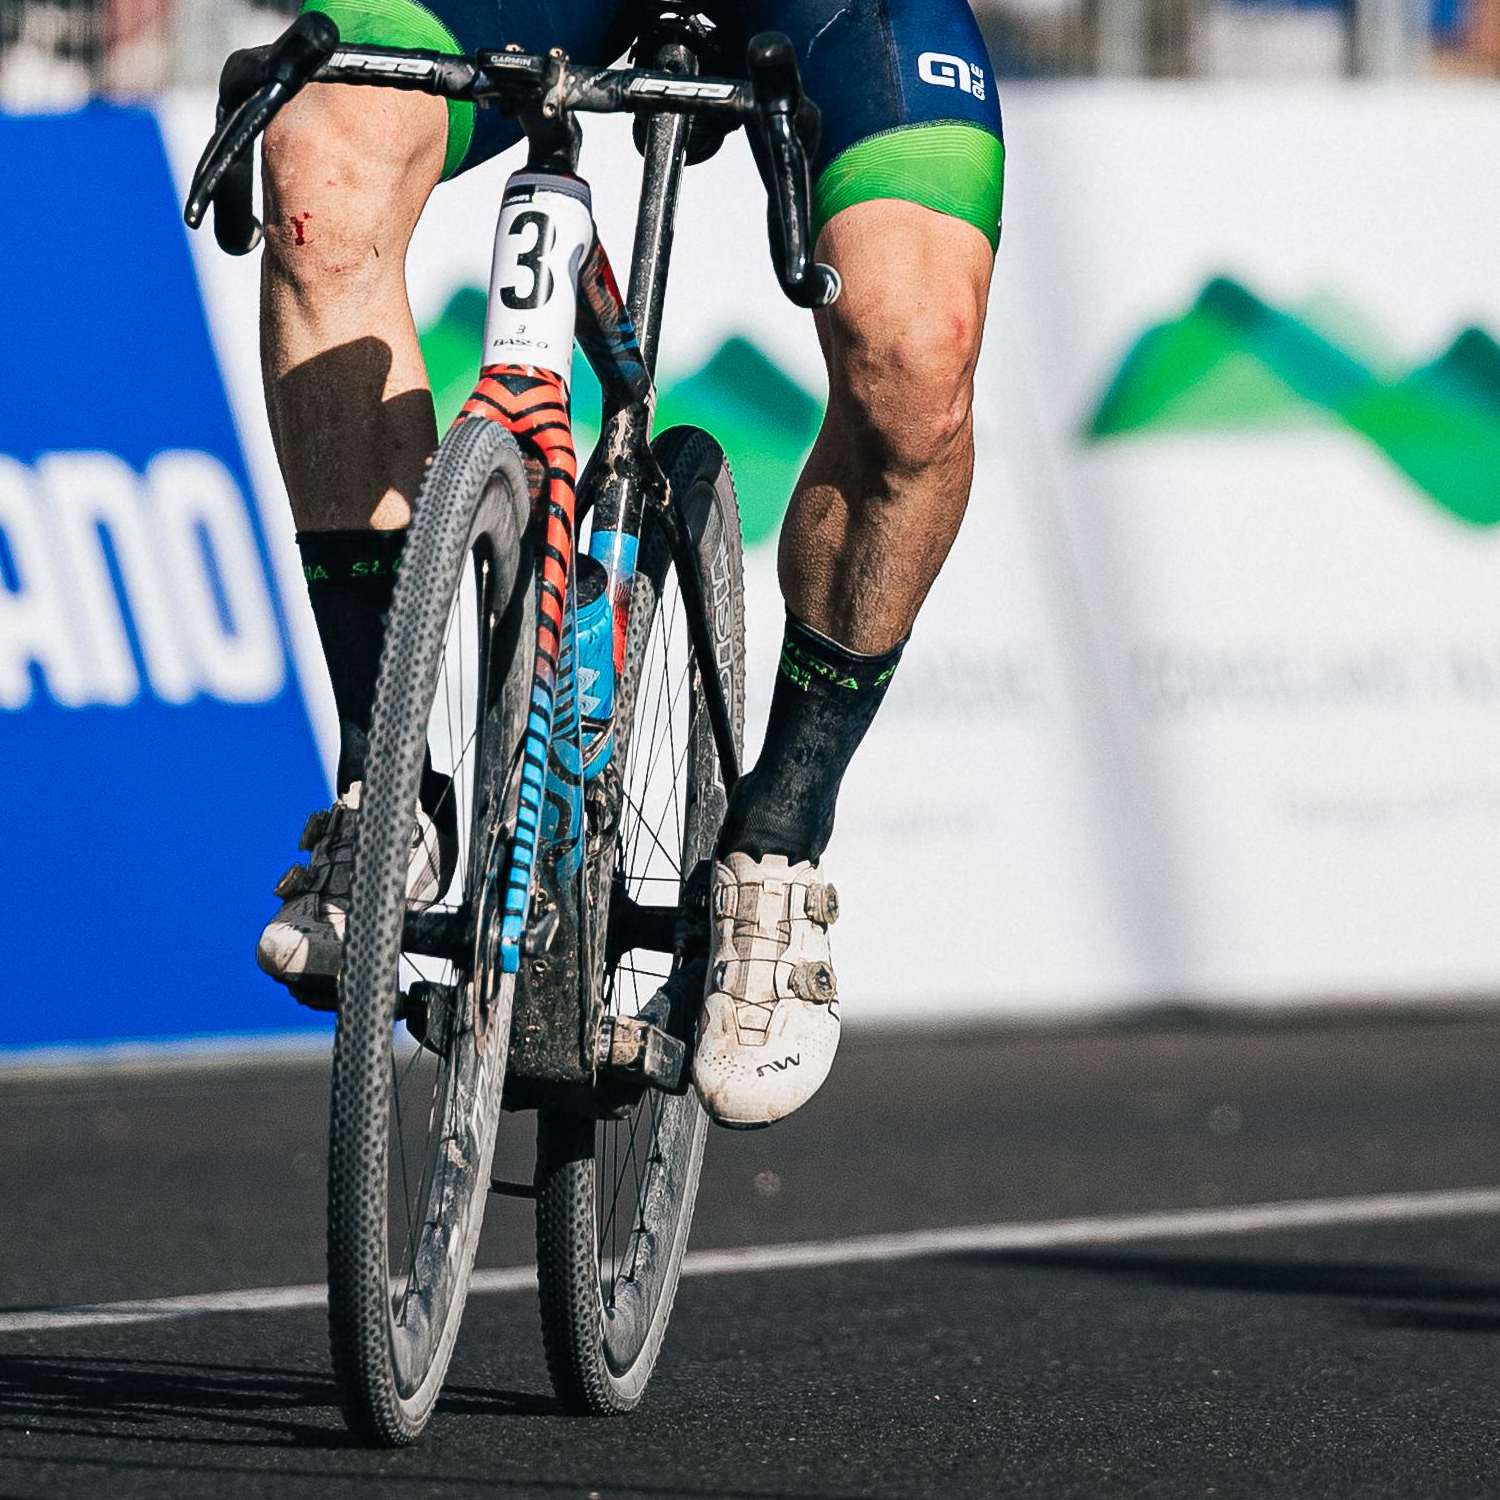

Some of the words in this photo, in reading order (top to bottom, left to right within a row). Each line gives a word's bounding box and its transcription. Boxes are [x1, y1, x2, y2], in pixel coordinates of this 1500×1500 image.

[490, 55, 532, 67] GARMIN
[499, 209, 557, 311] 3
[493, 338, 549, 349] BASSO
